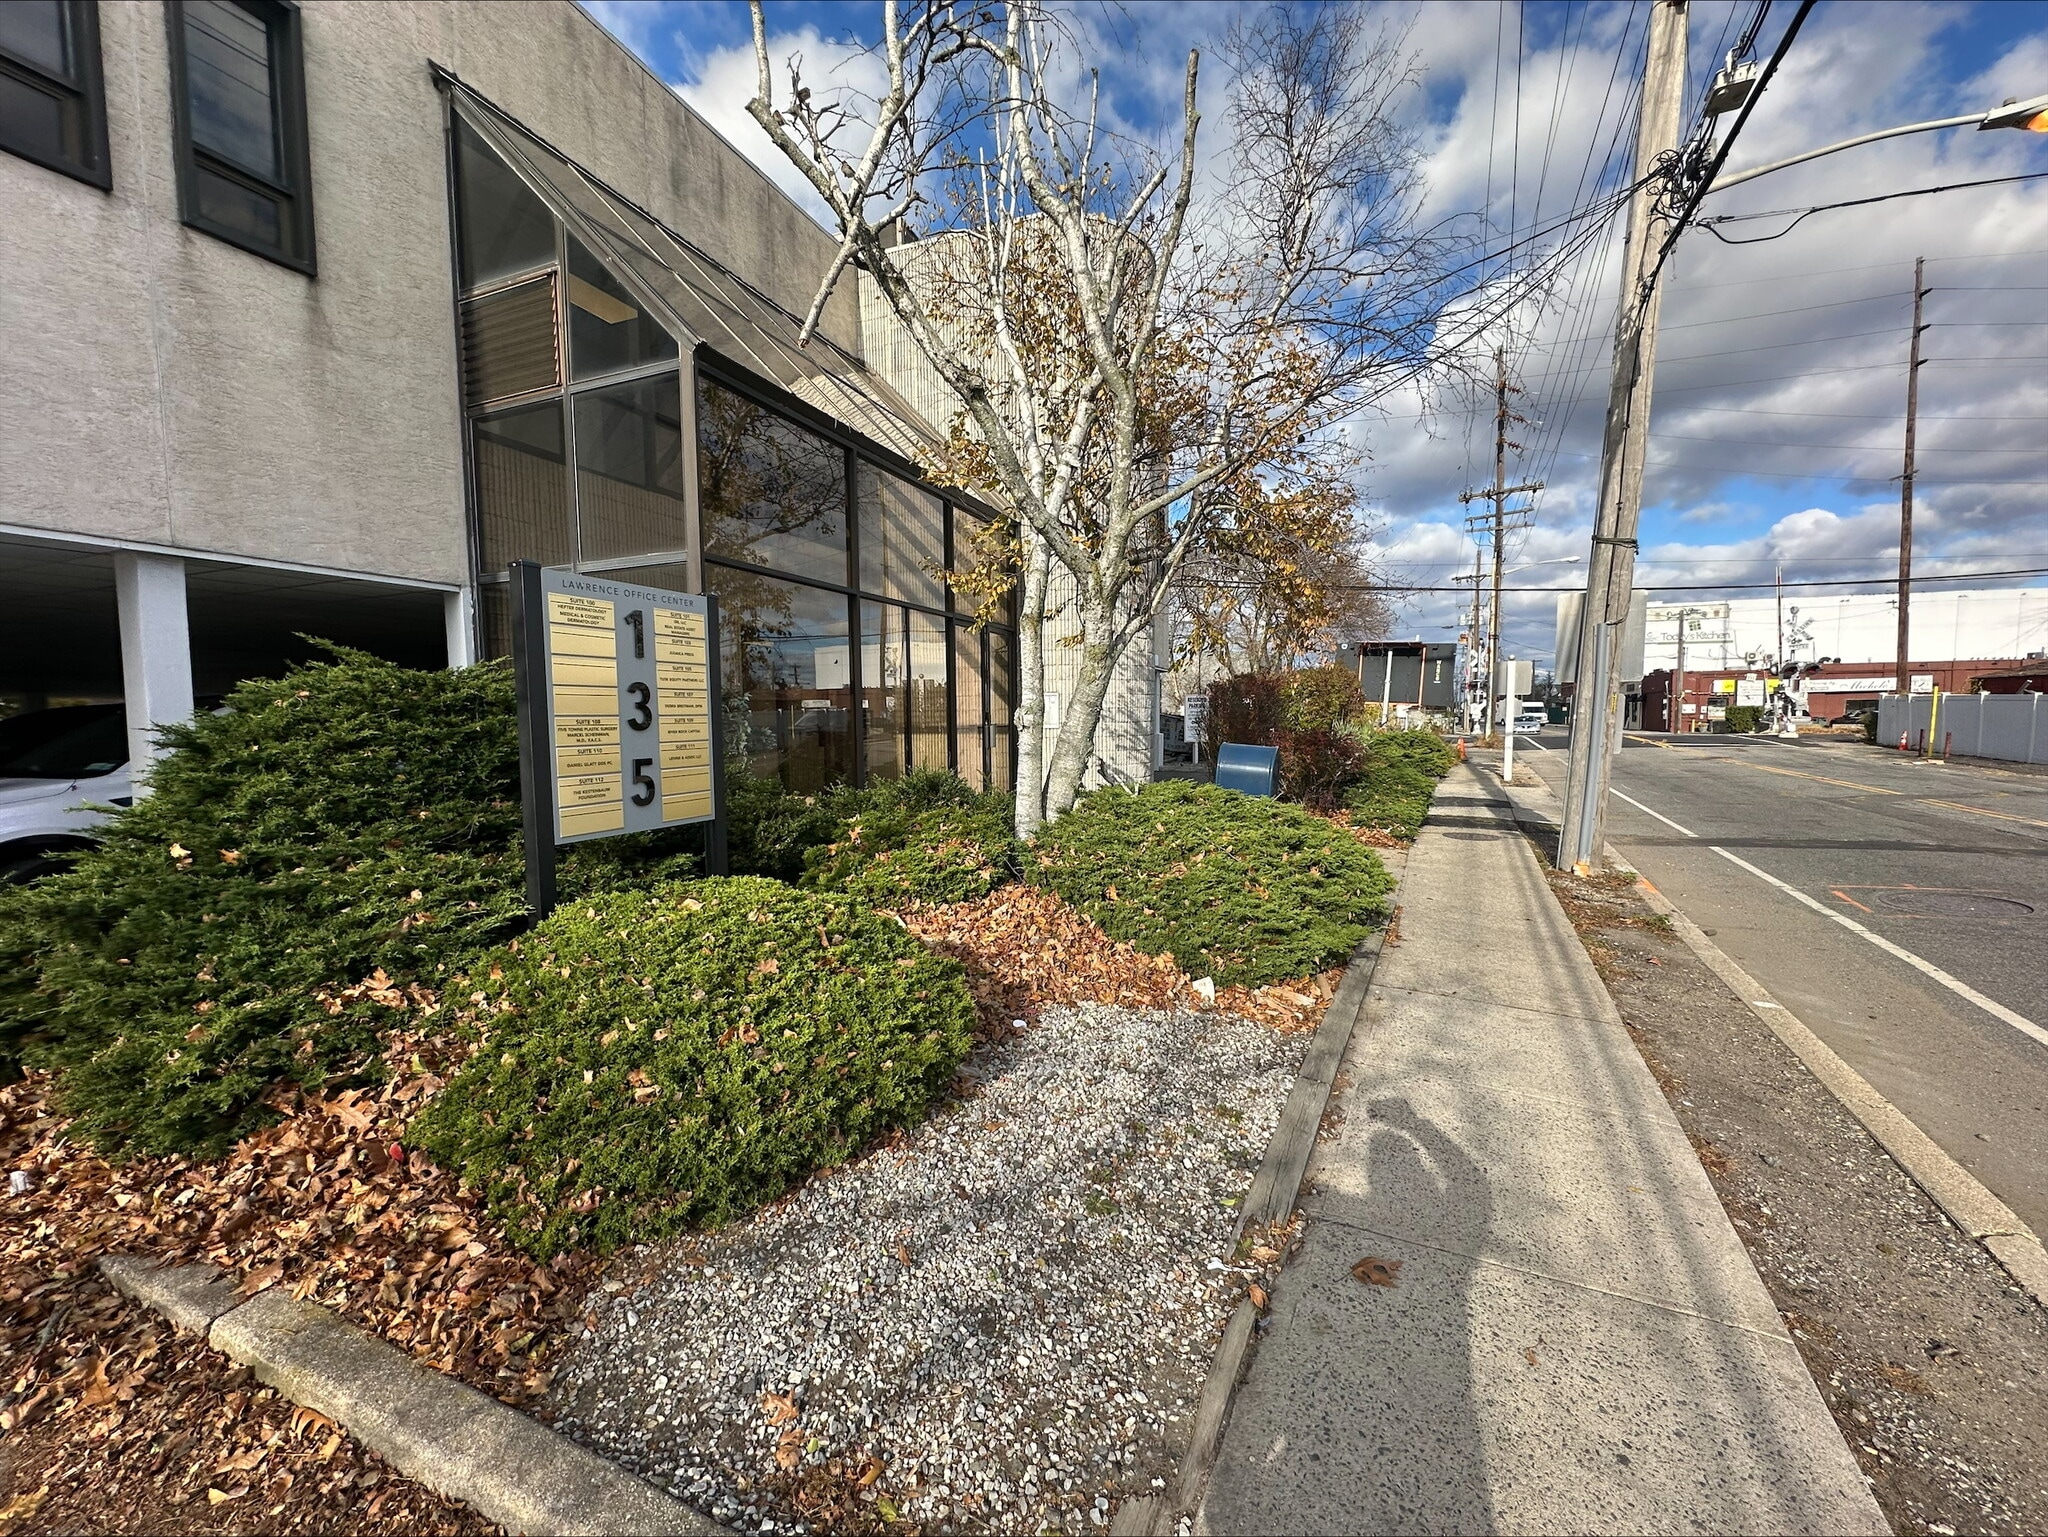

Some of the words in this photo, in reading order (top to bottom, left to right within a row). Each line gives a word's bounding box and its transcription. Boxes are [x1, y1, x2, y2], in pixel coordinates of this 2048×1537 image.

[562, 580, 619, 596] LAWRENCE
[624, 589, 657, 602] OFFICE
[662, 596, 694, 607] CENTER
[575, 606, 606, 614] DERMATOLOGY
[624, 610, 644, 658] 1
[1660, 631, 1695, 642] Tody's
[1696, 630, 1731, 640] Kitchen
[628, 682, 652, 731] 3
[631, 758, 656, 806] 5
